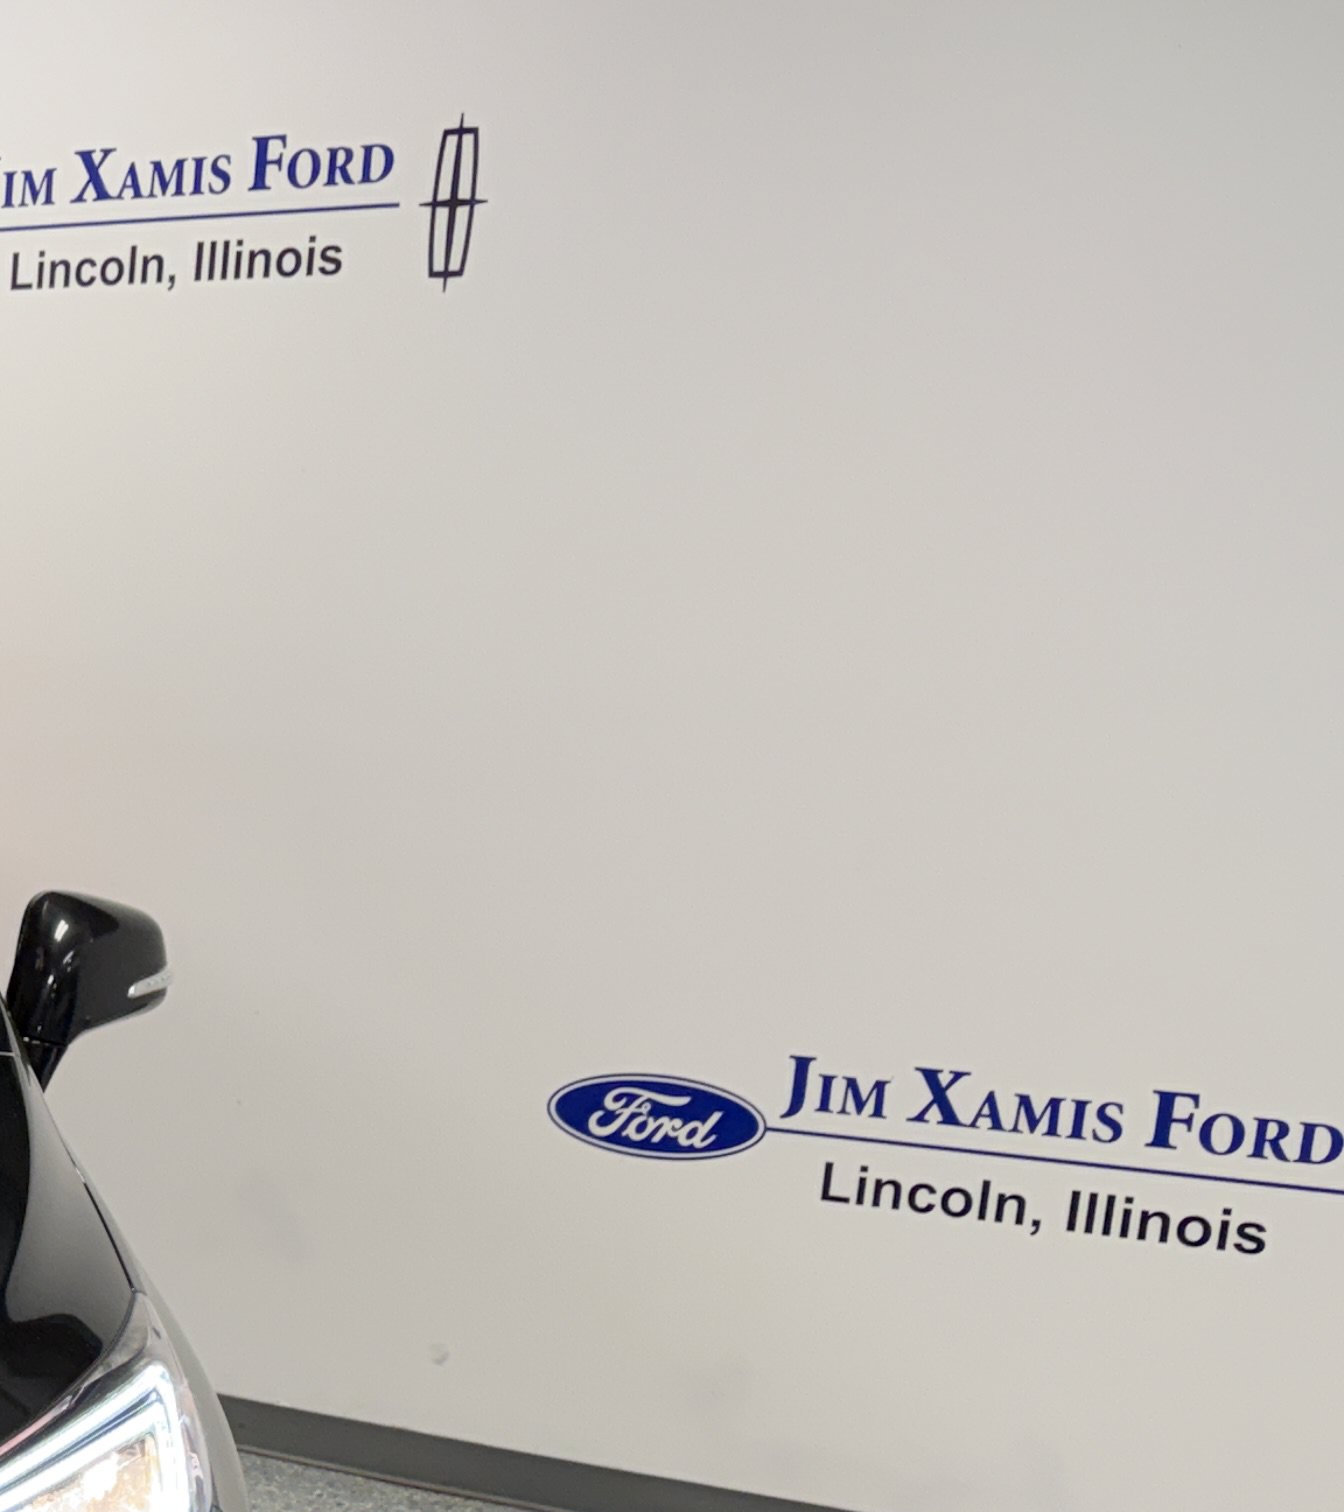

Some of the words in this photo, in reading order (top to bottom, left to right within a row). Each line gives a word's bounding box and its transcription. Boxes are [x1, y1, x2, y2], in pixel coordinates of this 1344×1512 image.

[11, 244, 176, 291] Lincoln,
[194, 236, 343, 281] Illinois
[587, 1086, 723, 1150] Ford
[820, 1162, 1042, 1235] Lincoln,
[1065, 1190, 1268, 1255] Illinois
